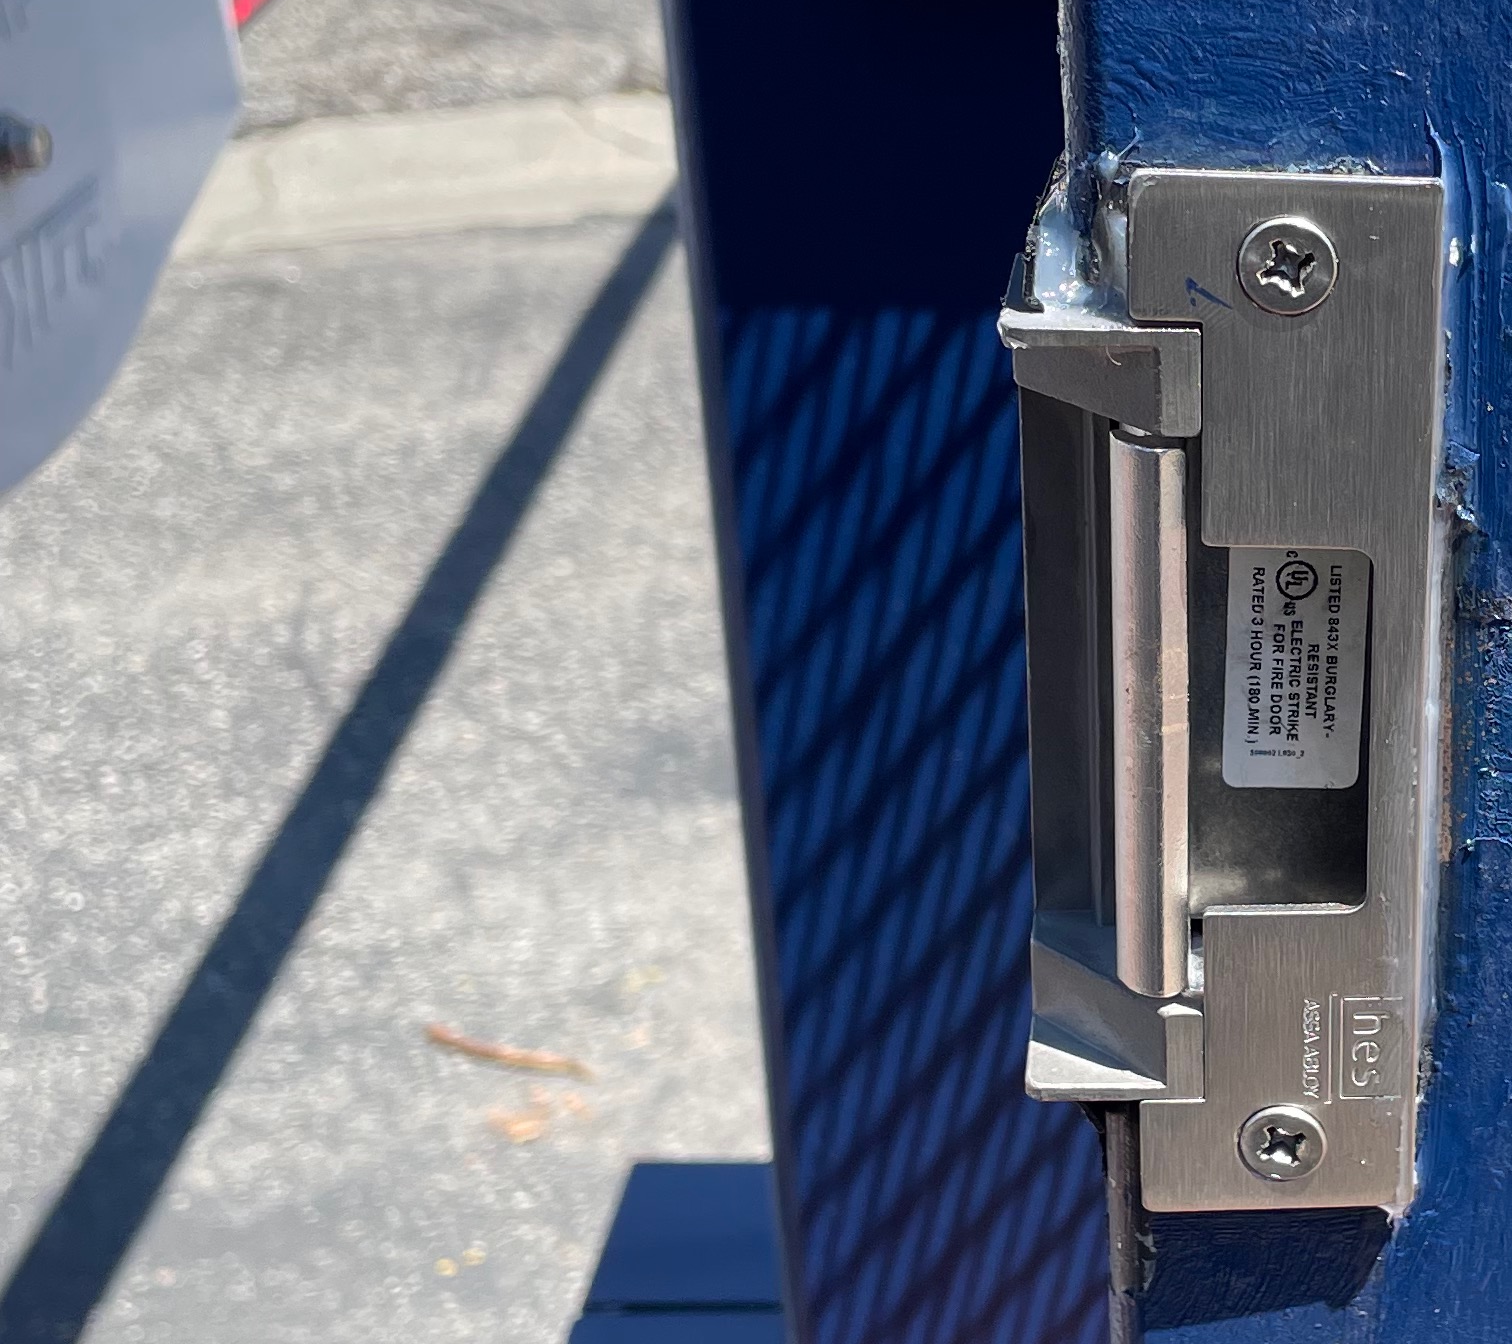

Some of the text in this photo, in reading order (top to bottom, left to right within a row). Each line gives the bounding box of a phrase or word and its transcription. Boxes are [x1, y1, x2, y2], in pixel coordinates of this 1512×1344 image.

[1252, 567, 1265, 613] RATED
[1249, 631, 1263, 671] HOUR
[1269, 624, 1285, 735] FOR FIRE DOOR
[1287, 621, 1303, 741] ELECTRIC STRIKE
[1305, 644, 1320, 718] RESISTANT
[1324, 566, 1342, 738] LISTED 843X BURGLARY-
[1247, 676, 1261, 704] (180
[1303, 999, 1320, 1098] ASSA ABLOY
[1352, 1011, 1391, 1087] hes
